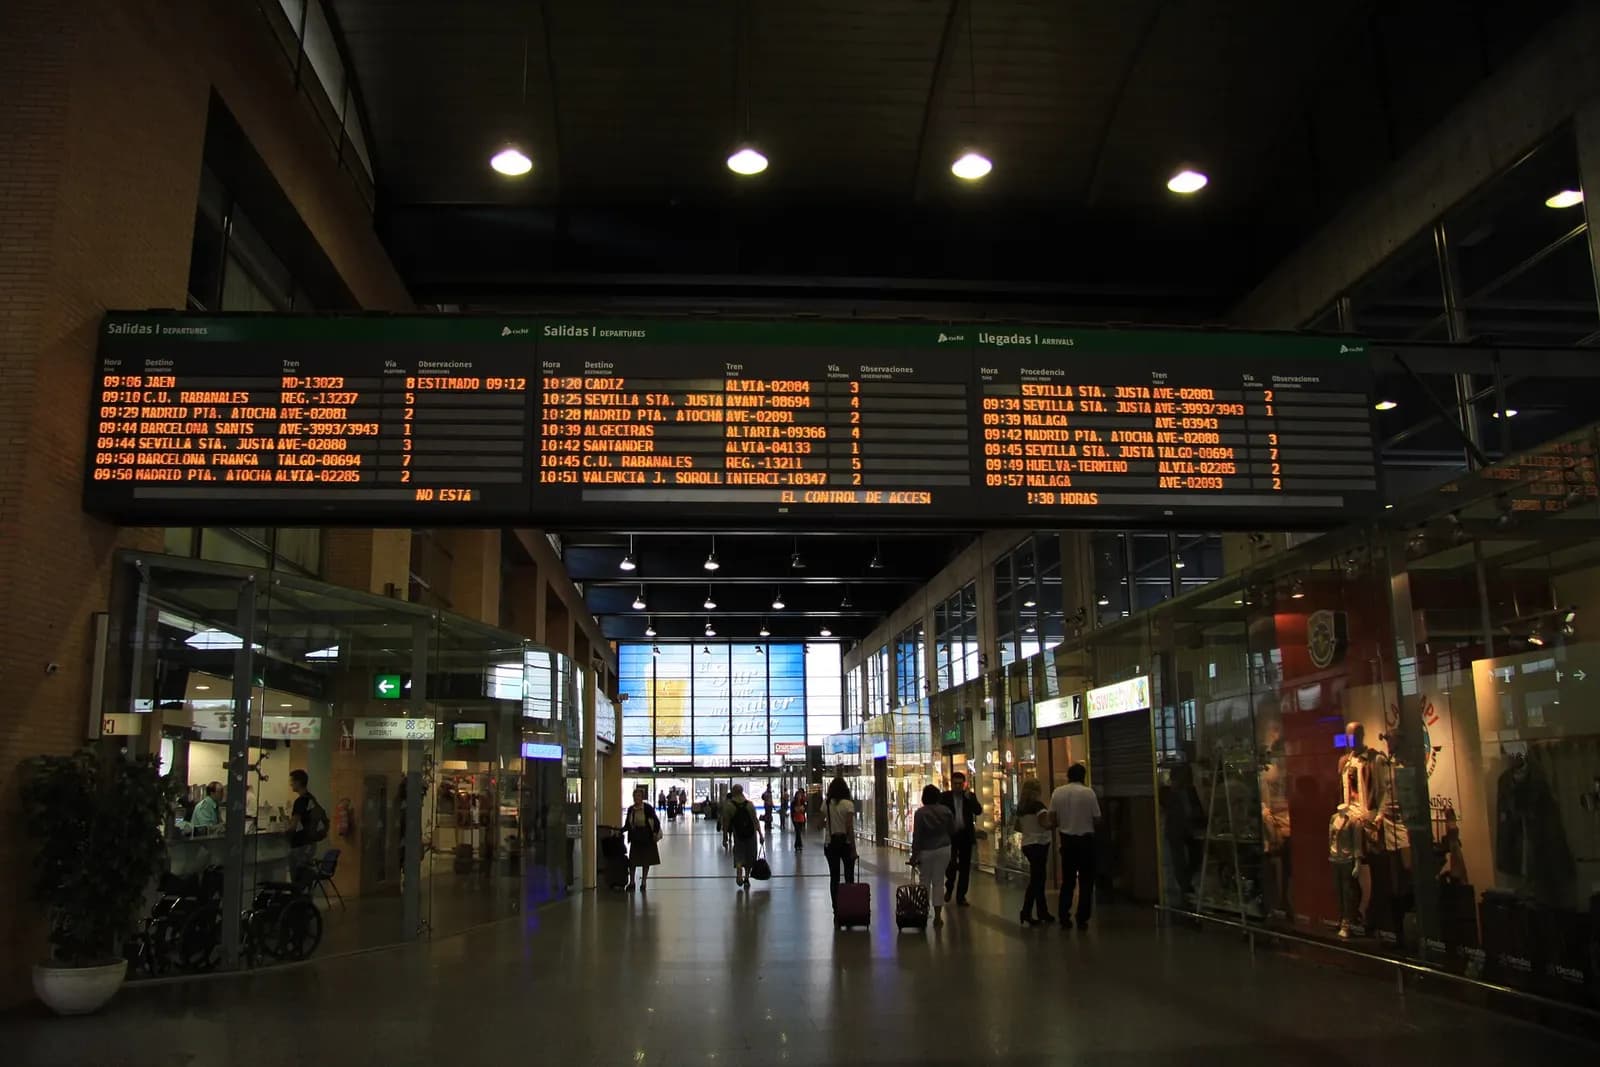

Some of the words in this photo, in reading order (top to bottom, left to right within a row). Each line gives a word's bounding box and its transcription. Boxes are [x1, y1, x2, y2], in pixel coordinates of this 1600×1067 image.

[108, 323, 152, 334] Salidas
[163, 327, 208, 335] DEPARTURES
[544, 326, 589, 337] Salidas
[979, 333, 1031, 345] Llegadas
[1042, 338, 1074, 346] ARRIVALS
[418, 360, 472, 368] Observaciones
[860, 365, 913, 373] Observaciones
[1020, 368, 1065, 376] Procedencia
[104, 376, 141, 387] 09:06
[145, 376, 175, 387] JAEN
[282, 377, 344, 388] MD-13023
[406, 377, 415, 389] 8
[418, 378, 480, 389] ESTIMADO
[486, 378, 525, 389] 09:12
[544, 378, 582, 389] 10:20
[585, 378, 624, 390] CADIZ
[726, 380, 810, 392] ALVIA-02084
[850, 382, 859, 393] 3
[103, 392, 141, 402] 09:10
[143, 392, 171, 403] C.U.
[181, 392, 248, 403] RABANALES
[281, 392, 358, 404] REG.-13237
[406, 393, 414, 404] 5
[1022, 385, 1073, 396] SEVILLA
[1079, 386, 1106, 397] STA.
[1116, 387, 1150, 398] JUSTA
[1153, 388, 1214, 400] AVE-02081
[1265, 391, 1272, 401] 2
[543, 393, 582, 405] 10:25
[585, 394, 639, 405] SEVILLA
[646, 394, 674, 405] STA.
[685, 394, 724, 406] JUSTA
[726, 395, 810, 407] AVANT-08694
[851, 397, 859, 408] 4
[101, 407, 139, 418] 09:29
[141, 407, 187, 418] MADRID
[194, 407, 220, 418] PTA.
[231, 408, 277, 419] ATOCHA
[280, 408, 346, 419] AVE-02081
[404, 408, 413, 419] 2
[983, 399, 1020, 410] 09:34
[1023, 399, 1074, 411] SEVILLA
[1080, 401, 1107, 412] STA.
[1117, 402, 1152, 413] JUSTA
[1154, 403, 1244, 414] AVE-3993/3943
[1266, 405, 1273, 416] 1
[543, 409, 581, 420] 10:28
[584, 409, 631, 420] MADRID
[637, 409, 666, 421] PTA.
[676, 410, 723, 422] ATOCHA
[726, 410, 794, 422] AVE-02091
[851, 412, 859, 423] 2
[984, 414, 1021, 425] 09:39
[1155, 417, 1218, 429] AVE-03943
[100, 422, 137, 433] 09:44
[140, 423, 208, 434] BARCELONA
[215, 423, 253, 434] SANTS
[279, 423, 378, 435] AVE-3993/3943
[404, 424, 411, 435] 1
[542, 424, 581, 436] 10:39
[584, 425, 654, 436] ALGECIRAS
[726, 426, 826, 438] ALTARIA-09366
[852, 427, 860, 438] 4
[97, 437, 135, 448] 09:44
[139, 438, 192, 449] SEVILLA
[199, 438, 226, 449] STA.
[237, 438, 274, 449] JUSTA
[277, 439, 346, 450] AVE-02080
[404, 439, 411, 450] 3
[985, 429, 1022, 440] 09:42
[1024, 429, 1069, 441] MADRID
[1074, 430, 1102, 441] PTA.
[1111, 431, 1154, 442] ATOCHA
[1156, 432, 1219, 443] AVE-02080
[1269, 434, 1277, 445] 3
[541, 440, 580, 451] 10:42
[583, 440, 654, 451] SANTANDER
[726, 442, 811, 453] ALVIA-04133
[852, 443, 859, 454] 1
[985, 443, 1022, 455] 09:45
[1025, 444, 1077, 456] SEVILLA
[1083, 445, 1110, 457] STA.
[1120, 446, 1155, 457] JUSTA
[1158, 447, 1234, 459] TALGO-00694
[1271, 449, 1278, 460] 7
[96, 453, 135, 464] 09:50
[137, 453, 206, 465] BARCELONA
[212, 454, 258, 465] FRANÇA
[279, 454, 361, 466] TALGO-00694
[403, 455, 411, 466] 7
[541, 455, 580, 467] 10:45
[583, 456, 612, 467] C.U.
[621, 456, 693, 468] RABANALES
[726, 457, 803, 469] REG.-13211
[852, 458, 861, 469] 5
[986, 459, 1024, 470] 09:49
[1026, 460, 1128, 472] HUELVA-TERMINO
[1159, 462, 1236, 474] ALVIA-02285
[1272, 463, 1279, 474] 2
[94, 469, 133, 480] 09:50
[135, 469, 182, 480] MADRID
[188, 469, 216, 480] PTA.
[226, 470, 272, 481] ATOCHA
[275, 470, 360, 481] ALVIA-02285
[401, 471, 409, 482] 2
[541, 471, 577, 482] 10:51
[583, 471, 645, 483] VALENCIA
[653, 472, 666, 483] J.
[676, 472, 721, 484] SOROLL
[726, 473, 826, 484] INTERCI-10347
[853, 473, 861, 485] 2
[986, 474, 1024, 486] 09:57
[1160, 477, 1223, 488] AVE-02093
[1273, 478, 1280, 489] 2
[416, 489, 433, 500] NO
[781, 491, 796, 503] EL
[804, 491, 857, 503] CONTROL
[865, 491, 881, 503] DE
[1060, 493, 1098, 504] HORAS
